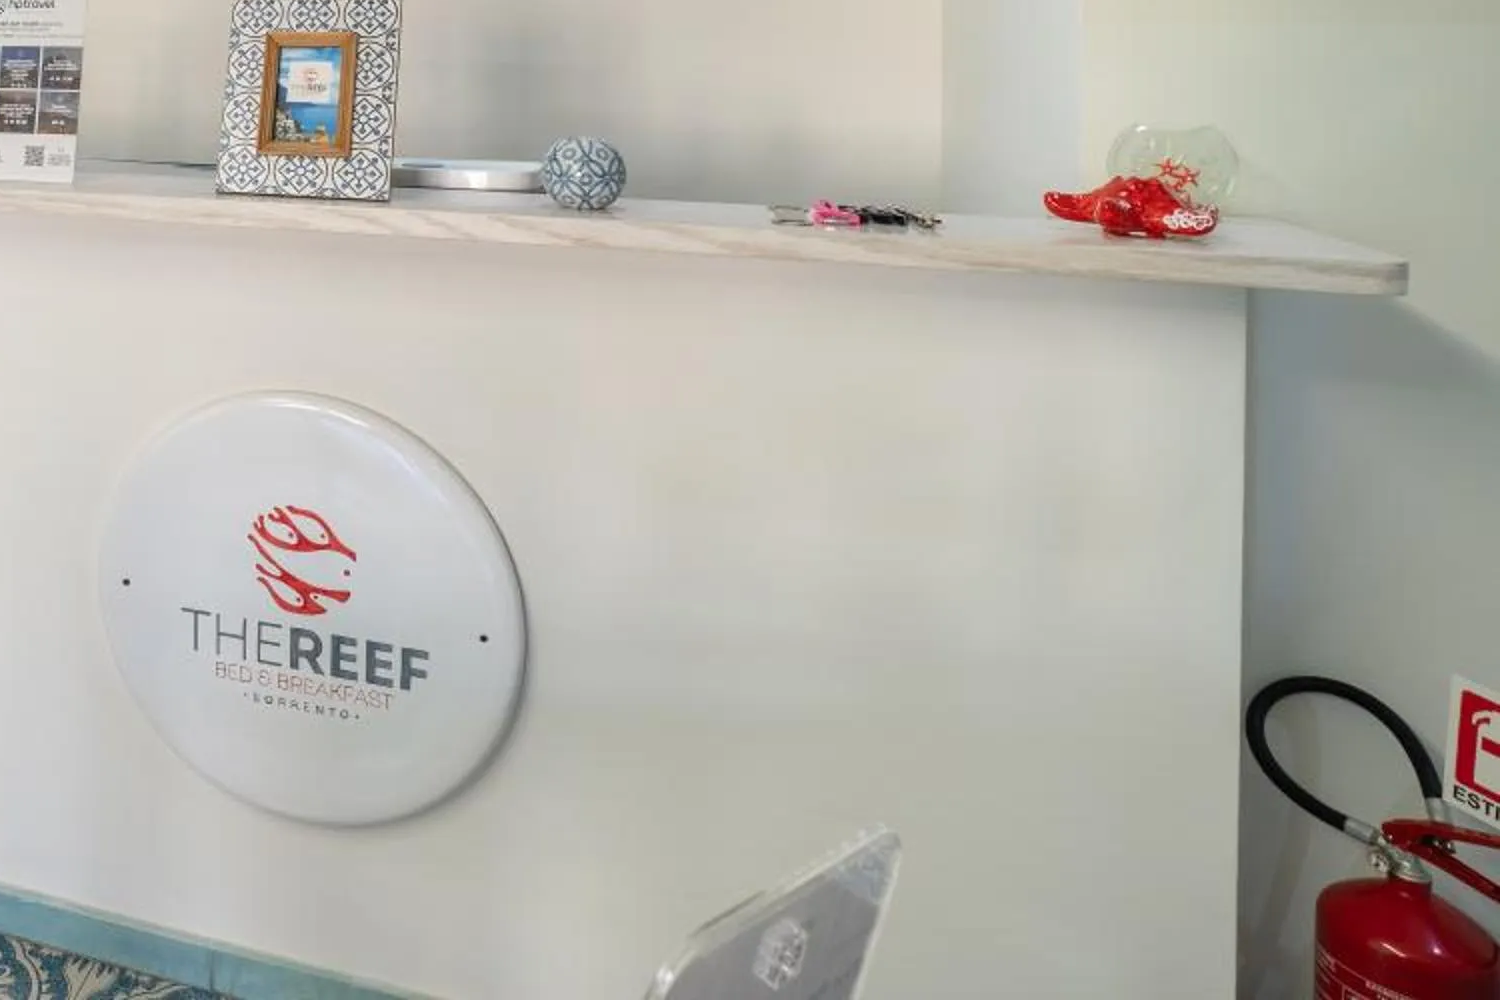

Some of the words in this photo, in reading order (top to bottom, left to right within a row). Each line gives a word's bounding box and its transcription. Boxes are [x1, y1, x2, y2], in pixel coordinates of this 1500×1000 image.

[214, 661, 253, 684] BED
[276, 672, 397, 711] BREAKFAST
[252, 692, 350, 720] SORRENTO
